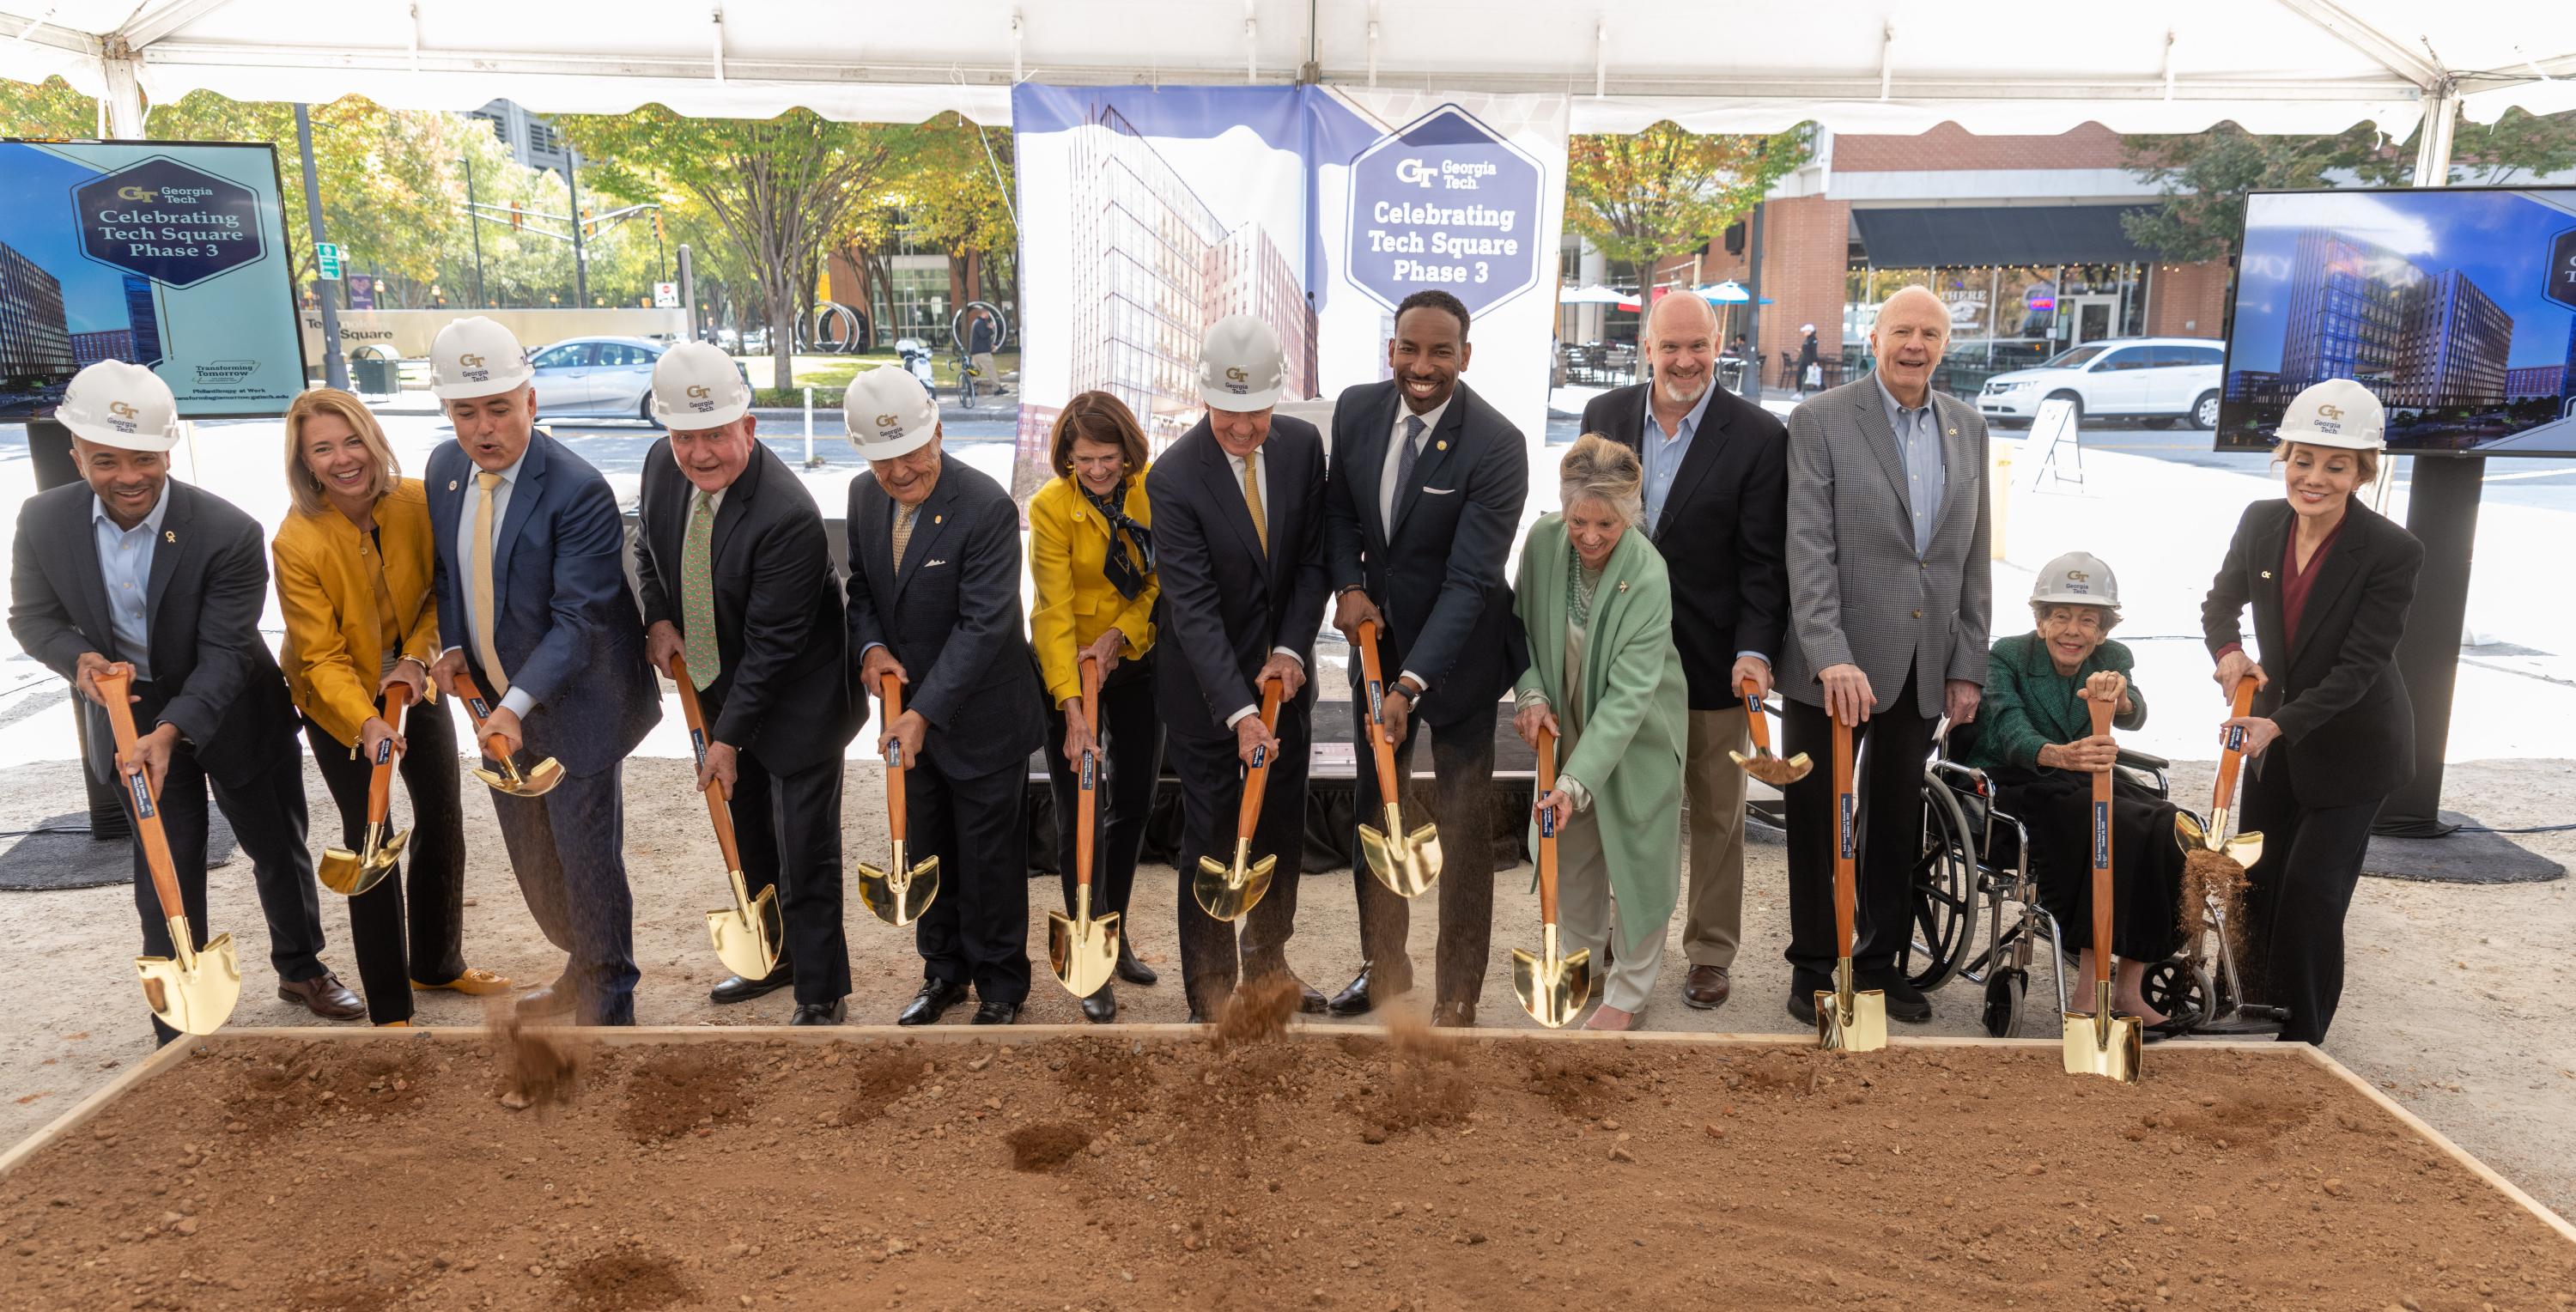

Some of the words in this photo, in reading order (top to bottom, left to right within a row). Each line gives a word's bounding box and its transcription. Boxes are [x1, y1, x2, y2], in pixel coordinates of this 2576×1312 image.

[1396, 159, 1438, 187] GT
[1442, 160, 1497, 177] Georgia
[1443, 175, 1477, 189] Tech
[118, 186, 158, 203] GT
[161, 187, 213, 197] Georgia
[99, 210, 240, 228] Celebrating
[1374, 201, 1516, 232] Celebrating
[99, 227, 156, 240] Tech
[161, 228, 243, 245] Square
[129, 243, 199, 257] Phase
[206, 245, 219, 257] 3
[1368, 229, 1425, 253] Tech
[1431, 232, 1518, 259] Square
[1393, 259, 1467, 282] Phase
[1474, 261, 1488, 283] 3
[340, 329, 392, 341] Square
[462, 369, 489, 378] Georgia
[1225, 382, 1249, 391] Georgia
[689, 400, 714, 409] Georgia
[107, 417, 137, 428] Georgia
[2314, 420, 2342, 429] Georgia
[116, 425, 135, 434] Tech
[880, 427, 903, 437] Georgia
[2320, 426, 2337, 434] Tech
